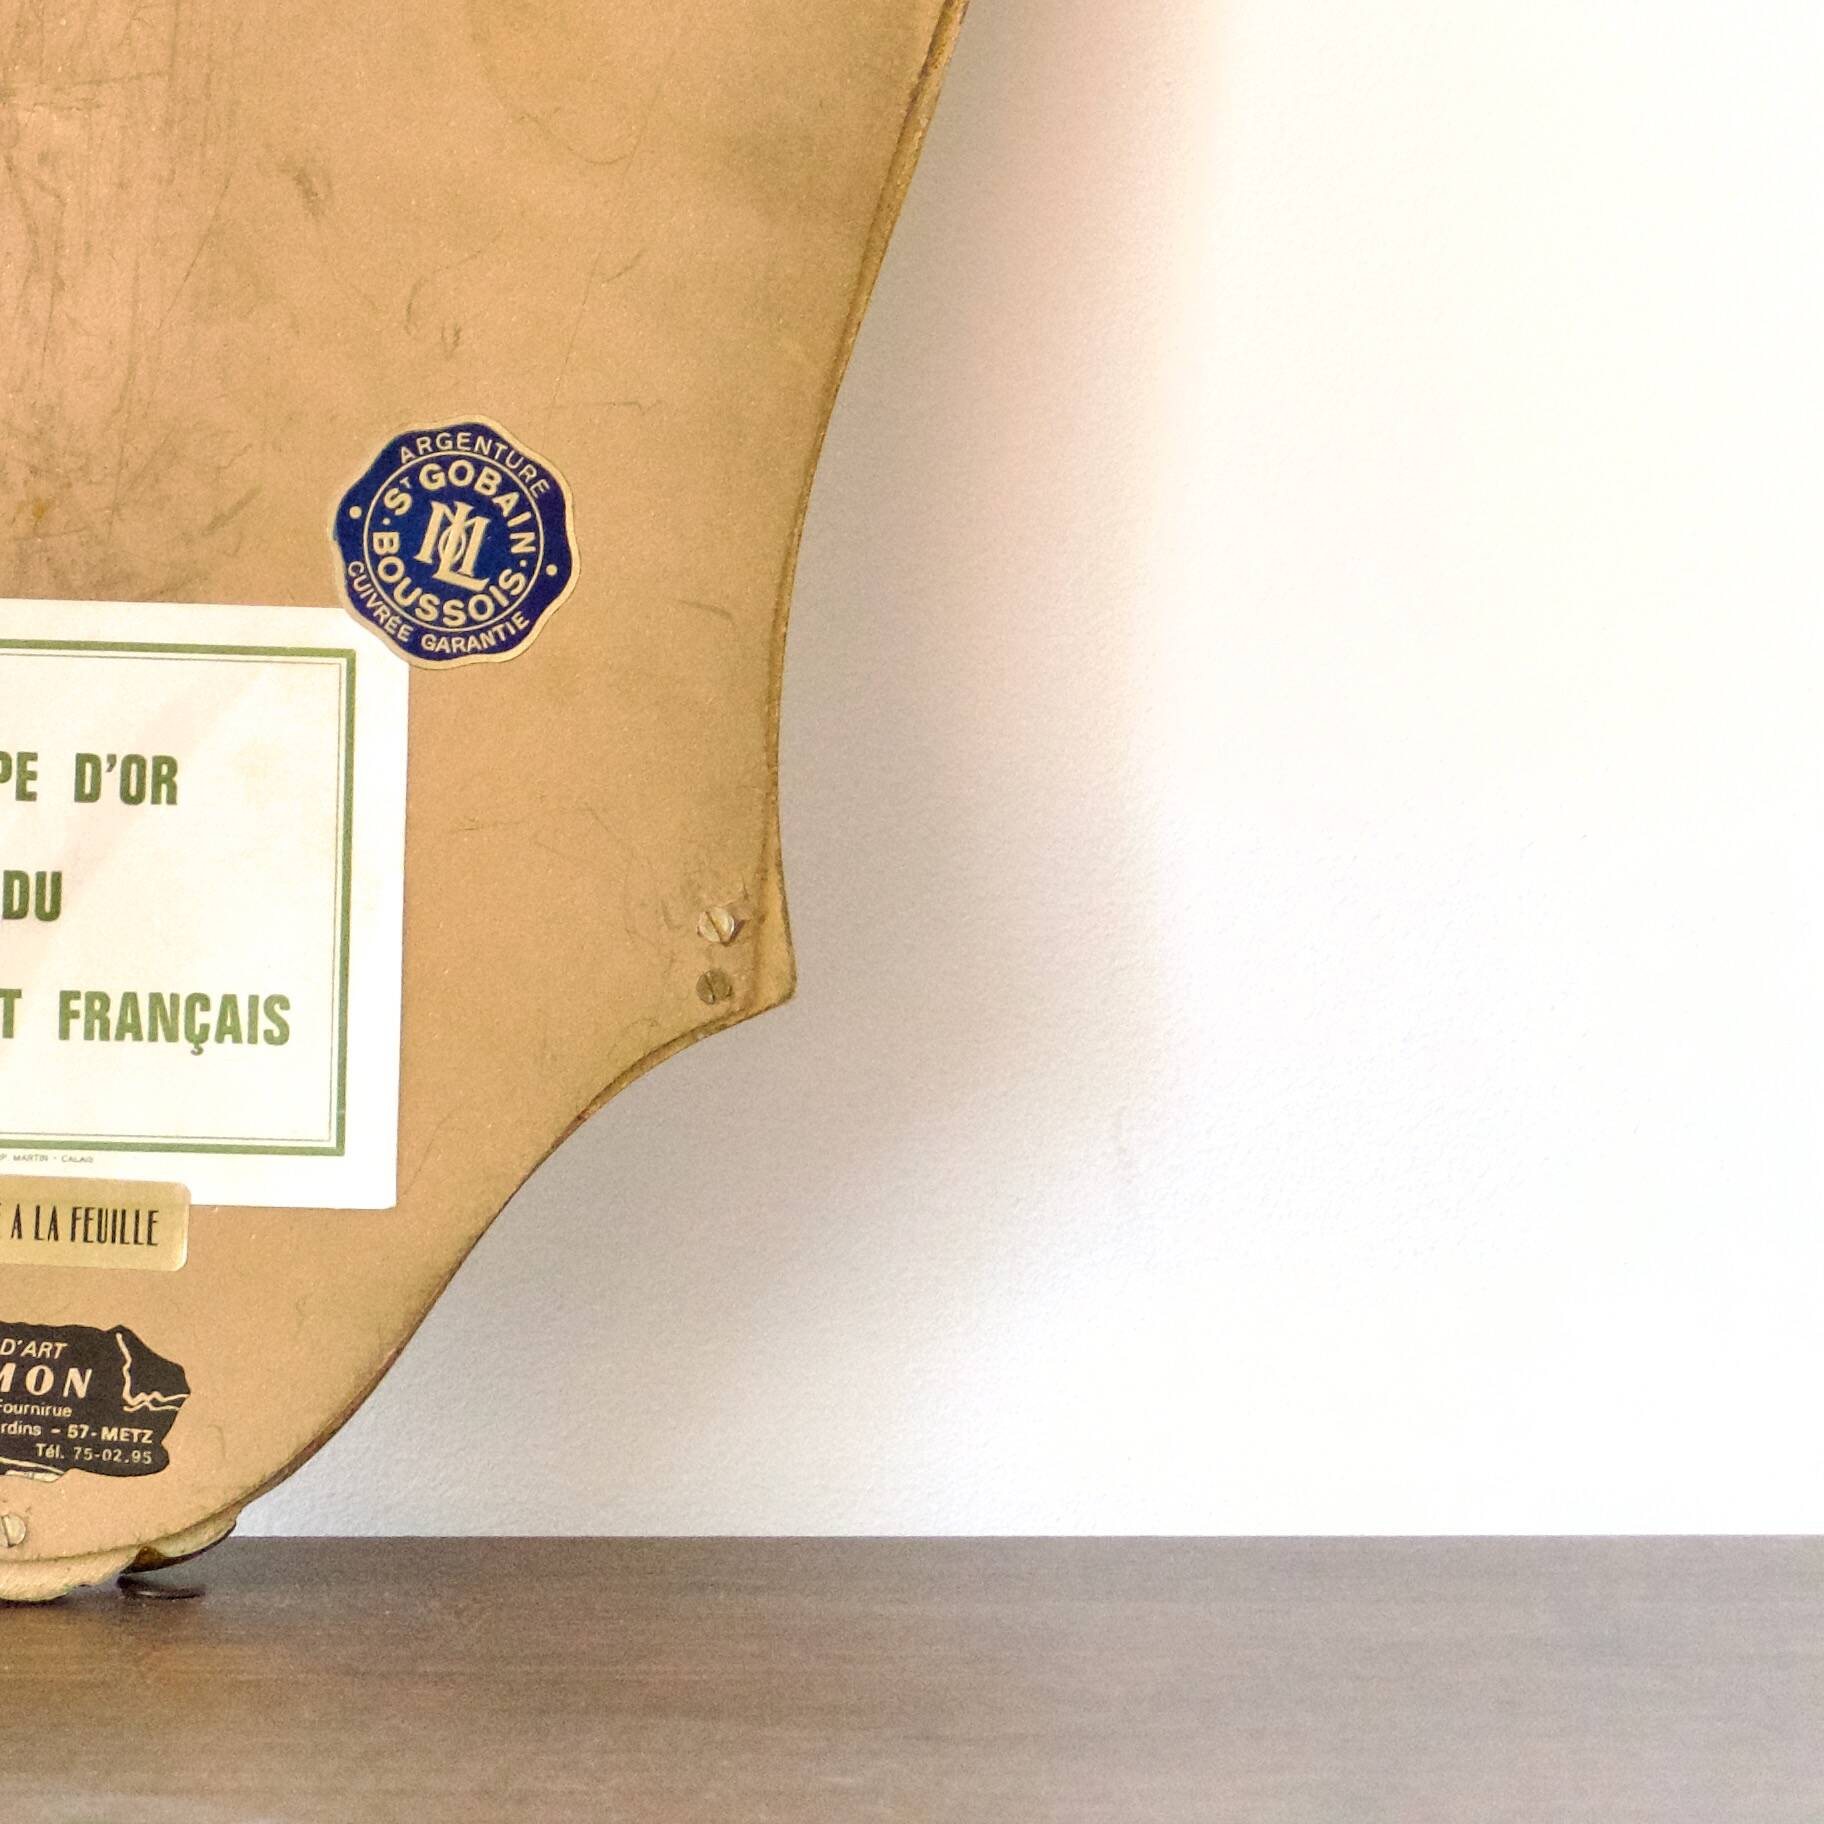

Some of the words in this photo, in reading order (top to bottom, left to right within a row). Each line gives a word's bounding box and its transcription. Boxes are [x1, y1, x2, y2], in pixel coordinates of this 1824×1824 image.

[399, 432, 550, 498] ARGENTURE
[418, 460, 537, 555] GOBAIN
[347, 560, 414, 642] CUIVRÉE
[420, 610, 530, 653] GARANTIE
[372, 531, 526, 627] BOUSSOIS
[73, 752, 179, 806] D'OR
[1, 869, 63, 923] DU
[56, 991, 292, 1058] FRANÇAIS
[10, 1205, 23, 1240] A
[34, 1205, 60, 1242] LA
[70, 1206, 160, 1246] FEUILLE
[0, 1340, 68, 1359] D'ART
[36, 1442, 64, 1460] Tél.
